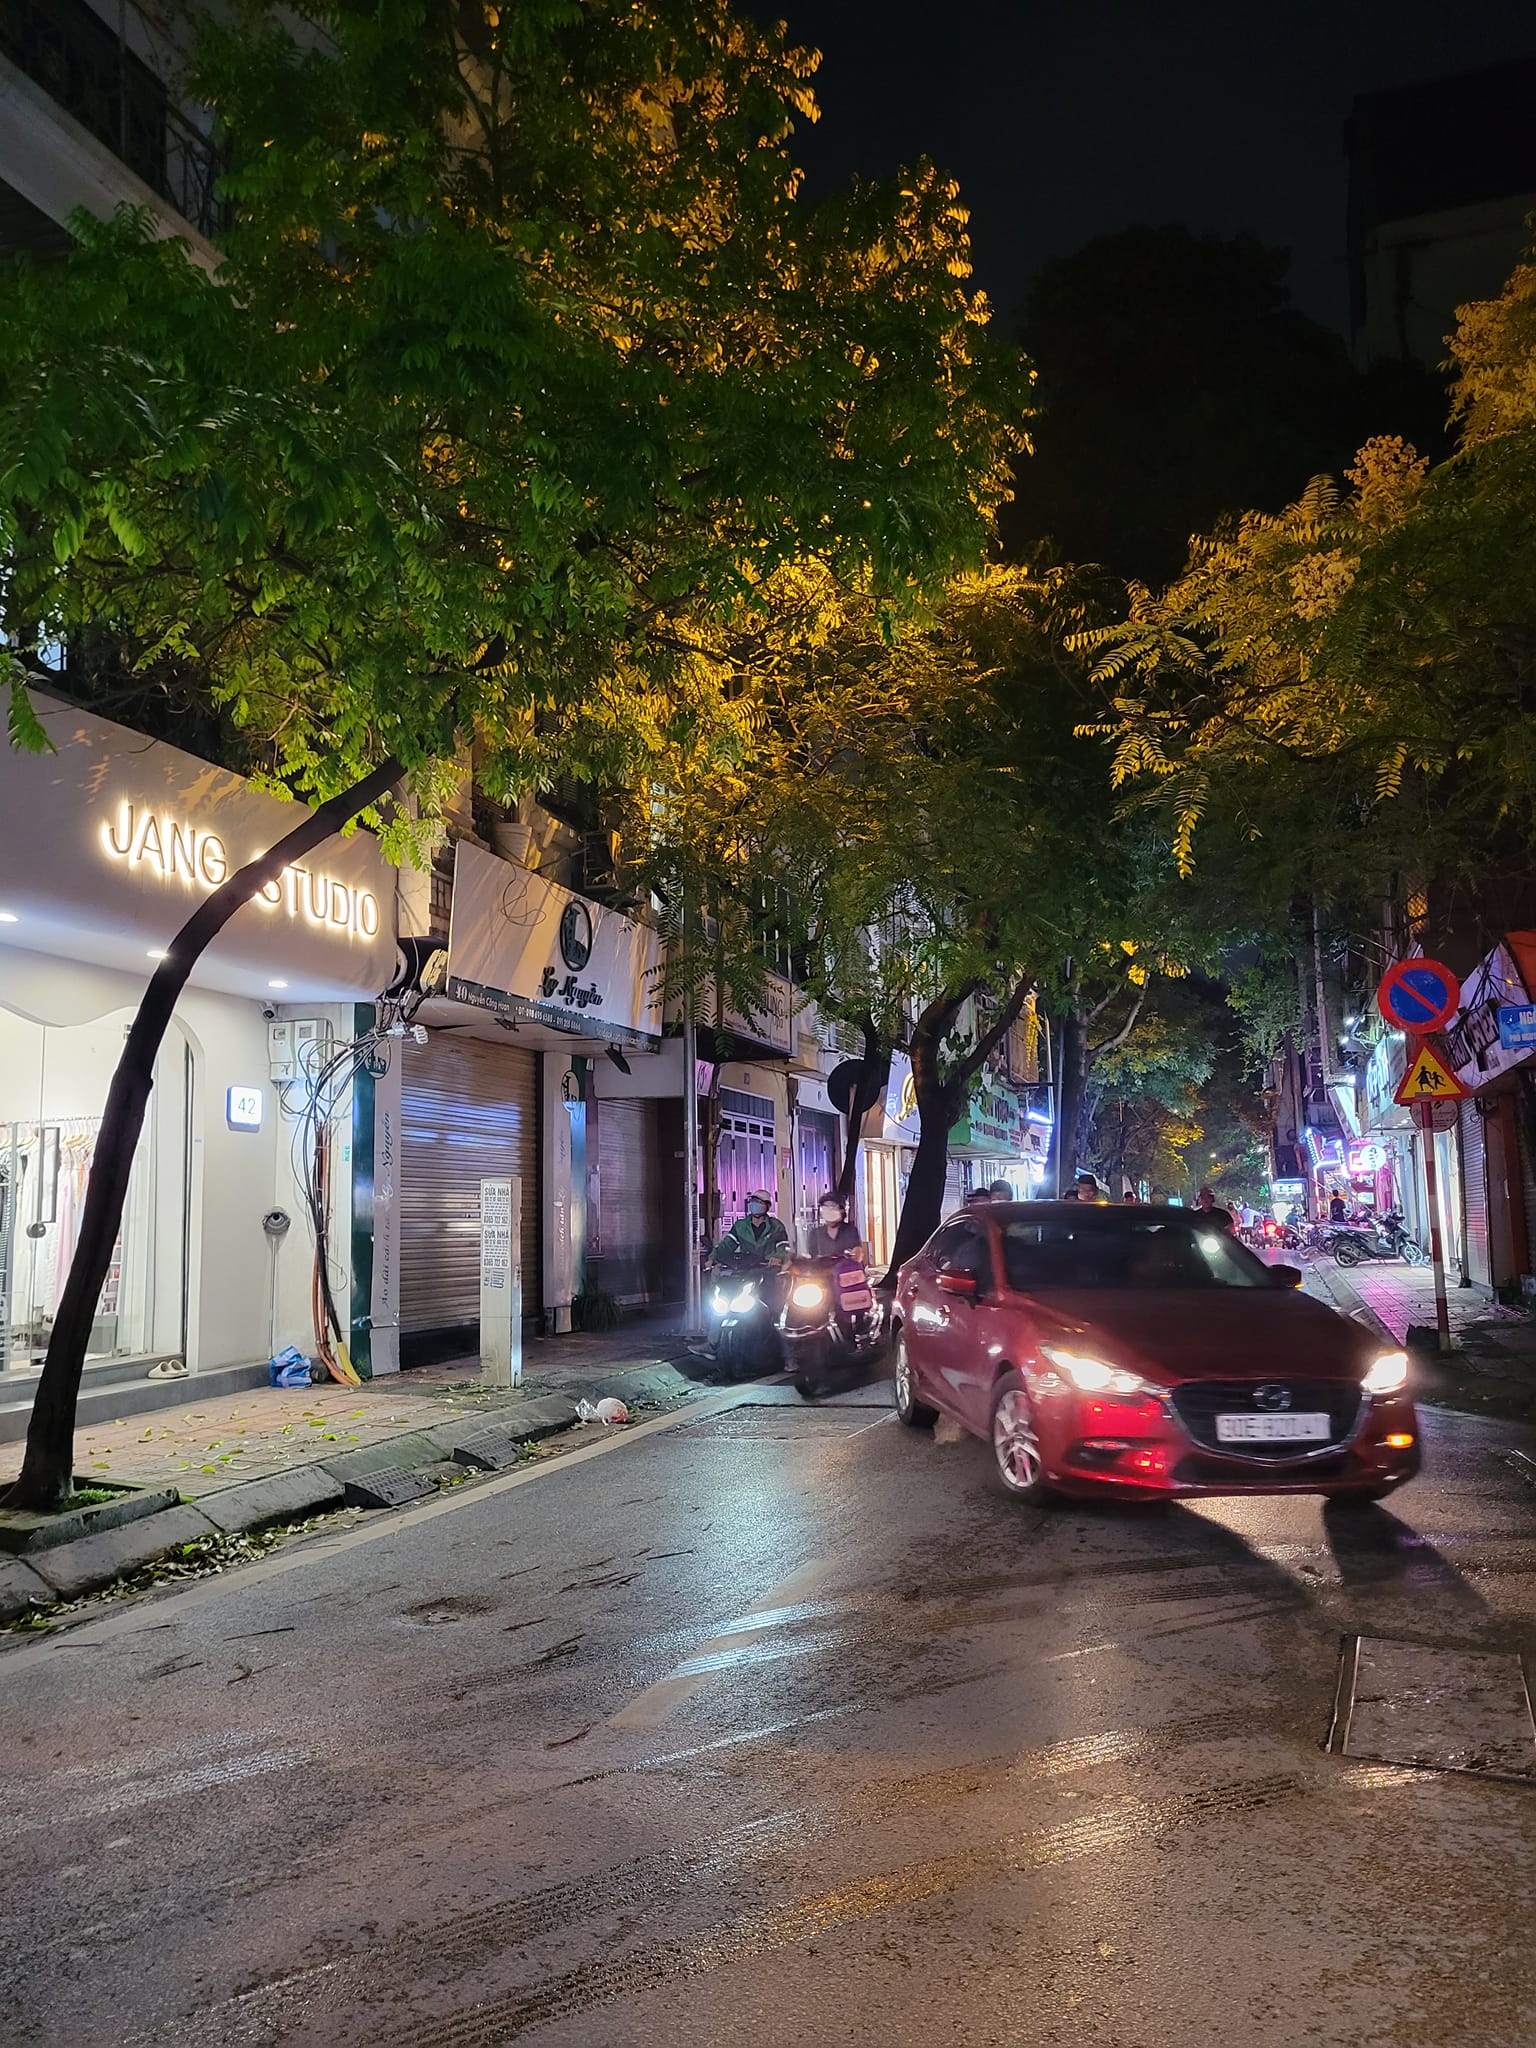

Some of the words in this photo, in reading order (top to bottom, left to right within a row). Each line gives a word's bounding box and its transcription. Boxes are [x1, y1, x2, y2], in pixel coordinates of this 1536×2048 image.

[108, 804, 228, 885] JANG
[455, 983, 468, 1002] 40
[1519, 1010, 1536, 1025] NG
[237, 1096, 256, 1115] 42
